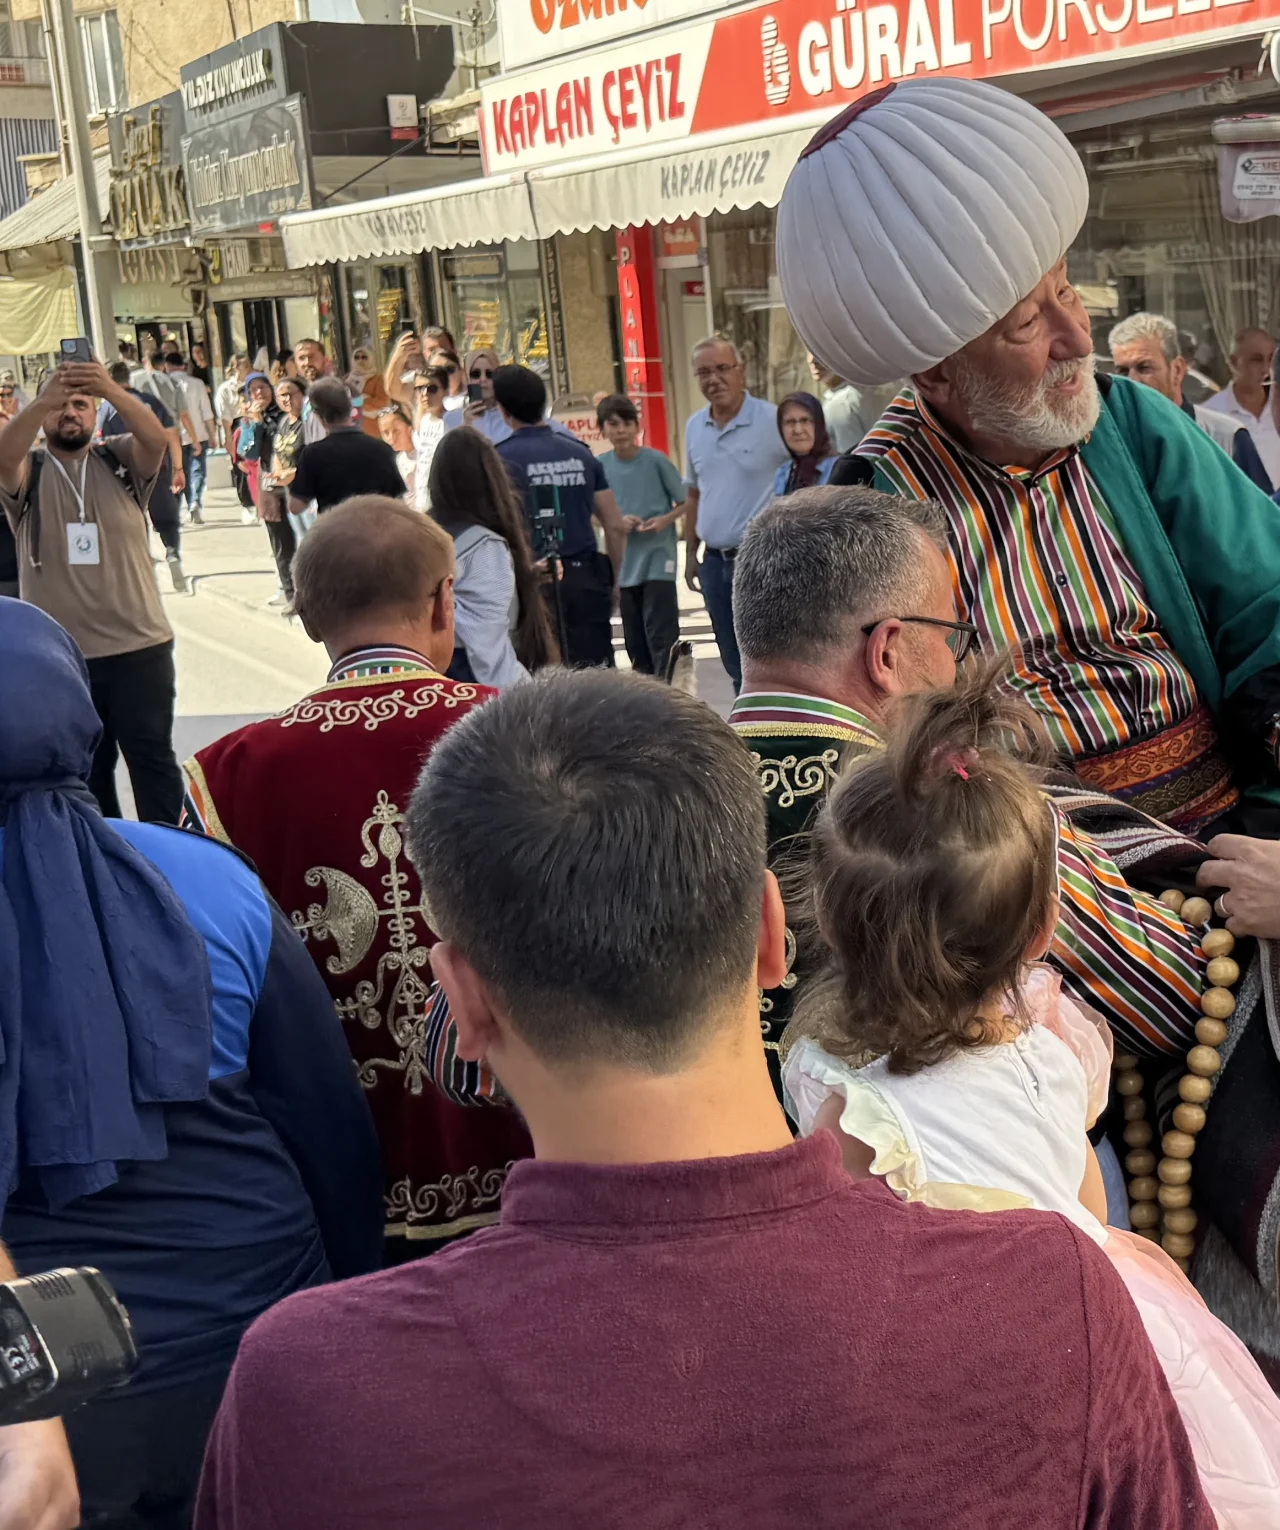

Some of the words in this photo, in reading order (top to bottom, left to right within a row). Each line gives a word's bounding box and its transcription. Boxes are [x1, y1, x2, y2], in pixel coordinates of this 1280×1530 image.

[798, 0, 972, 96] GÜRAL
[492, 76, 594, 158] KAPLAN
[602, 53, 685, 144] ÇEYİZ
[661, 158, 717, 200] KAPLAN
[719, 150, 770, 198] ÇEYİZ
[530, 472, 586, 486] ZABITA
